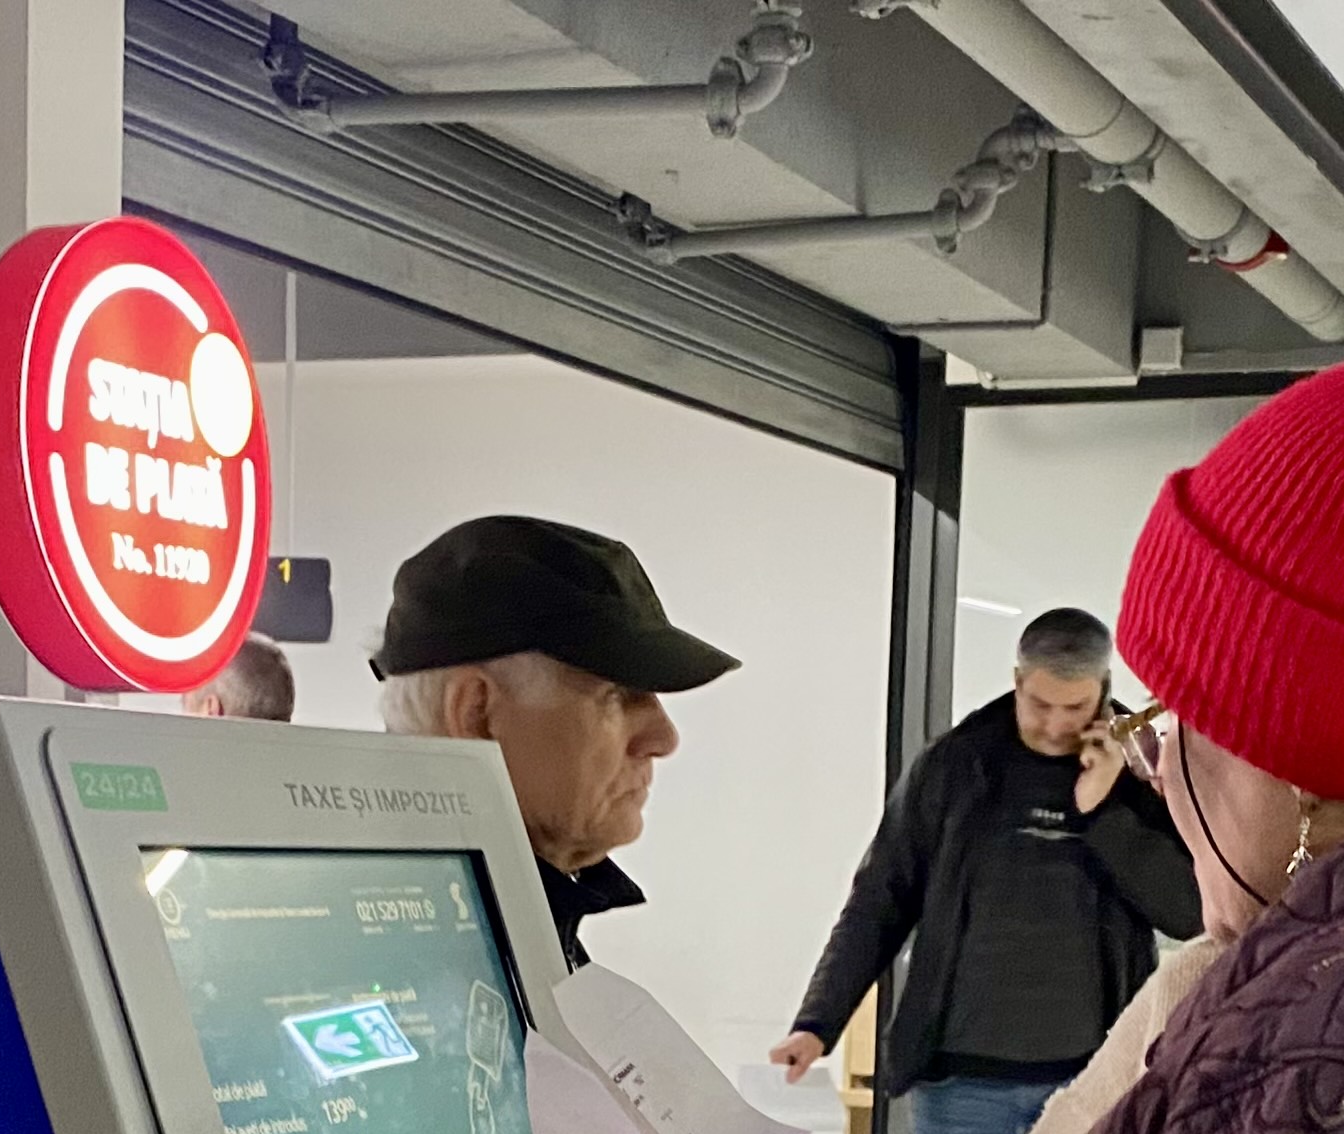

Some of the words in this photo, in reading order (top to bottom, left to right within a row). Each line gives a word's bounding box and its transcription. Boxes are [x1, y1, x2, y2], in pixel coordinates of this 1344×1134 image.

[85, 442, 131, 511] DE
[111, 532, 152, 575] No.
[278, 559, 291, 583] 1
[80, 771, 157, 800] 24/24
[284, 783, 346, 811] TAXE
[349, 788, 373, 817] ȘI
[375, 788, 473, 815] IMPOZITE
